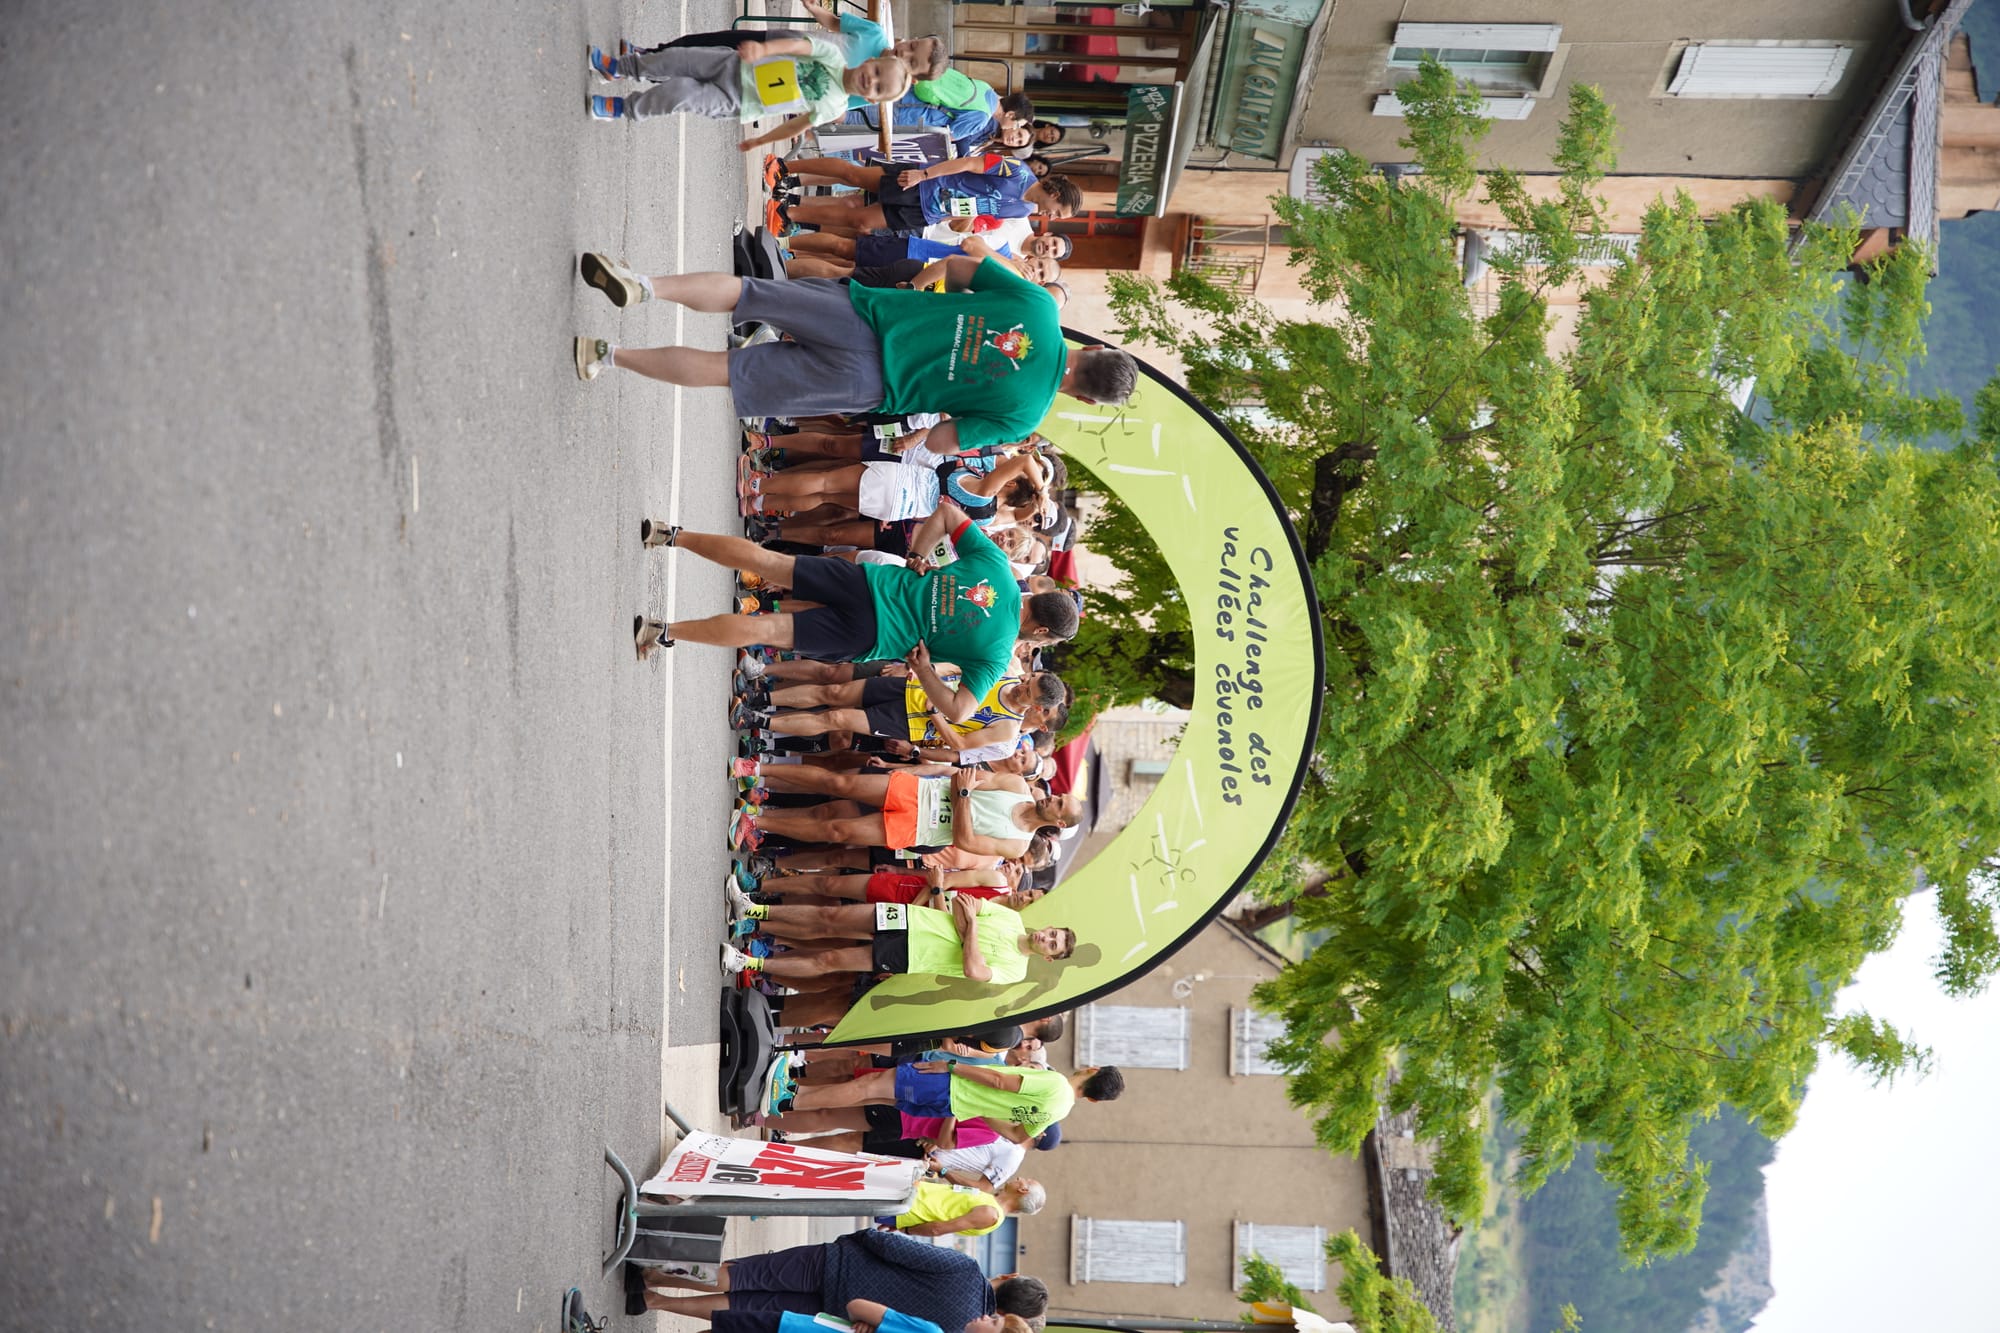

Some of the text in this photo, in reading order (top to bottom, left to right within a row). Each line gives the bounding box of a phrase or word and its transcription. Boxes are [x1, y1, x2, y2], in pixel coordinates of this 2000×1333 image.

[1250, 33, 1286, 67] AU
[768, 77, 785, 88] 1
[1145, 86, 1167, 107] PIZZA
[1126, 123, 1160, 184] PIZZERIA
[960, 202, 970, 216] 117
[1130, 194, 1154, 213] PIZZA
[953, 314, 964, 348] ISPAGNAC
[1216, 527, 1243, 806] vallées cévenoles
[1237, 547, 1273, 786] Challenge des
[940, 796, 951, 824] 115
[887, 906, 898, 920] 43
